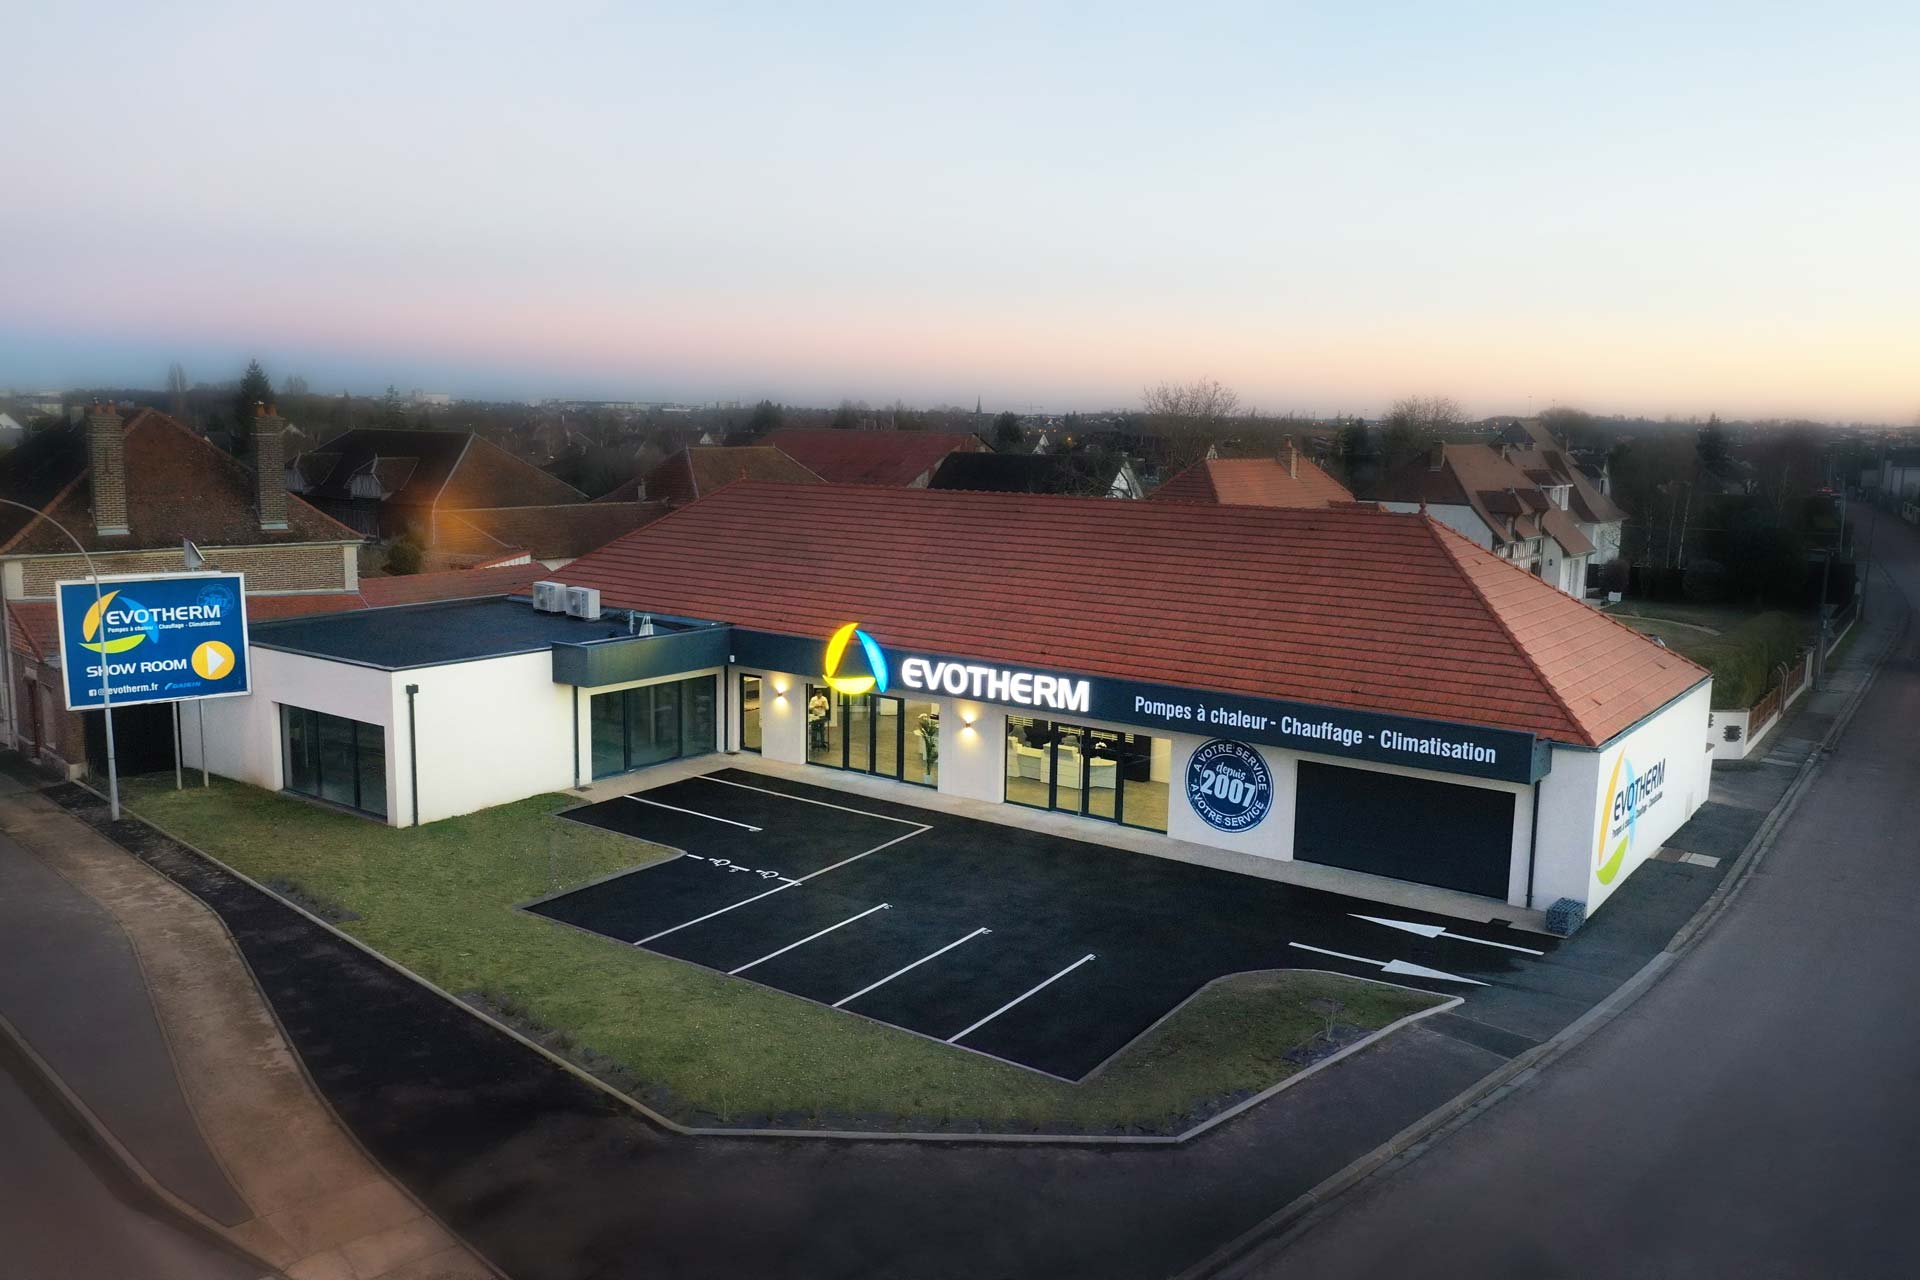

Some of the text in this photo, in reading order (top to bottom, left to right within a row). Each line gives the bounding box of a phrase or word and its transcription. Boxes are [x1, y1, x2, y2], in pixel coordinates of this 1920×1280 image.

[106, 605, 220, 625] EVOTHERM
[158, 622, 184, 630] Chauffage
[188, 620, 221, 628] Climatisation
[86, 659, 187, 677] SHOW ROOM
[901, 658, 1090, 713] EVOTHERM
[1135, 695, 1192, 721] Pompes
[1196, 704, 1206, 722] à
[1210, 708, 1268, 730] chaleur
[1281, 716, 1363, 747] Chauffage
[1380, 729, 1496, 764] Climatisation
[1193, 743, 1267, 791] A VOTRE SERVICE
[1216, 761, 1246, 780] depuis
[1190, 783, 1265, 827] A VOTRE SERVICE
[1200, 769, 1256, 808] 2007
[1613, 757, 1666, 821] EVOTHERM
